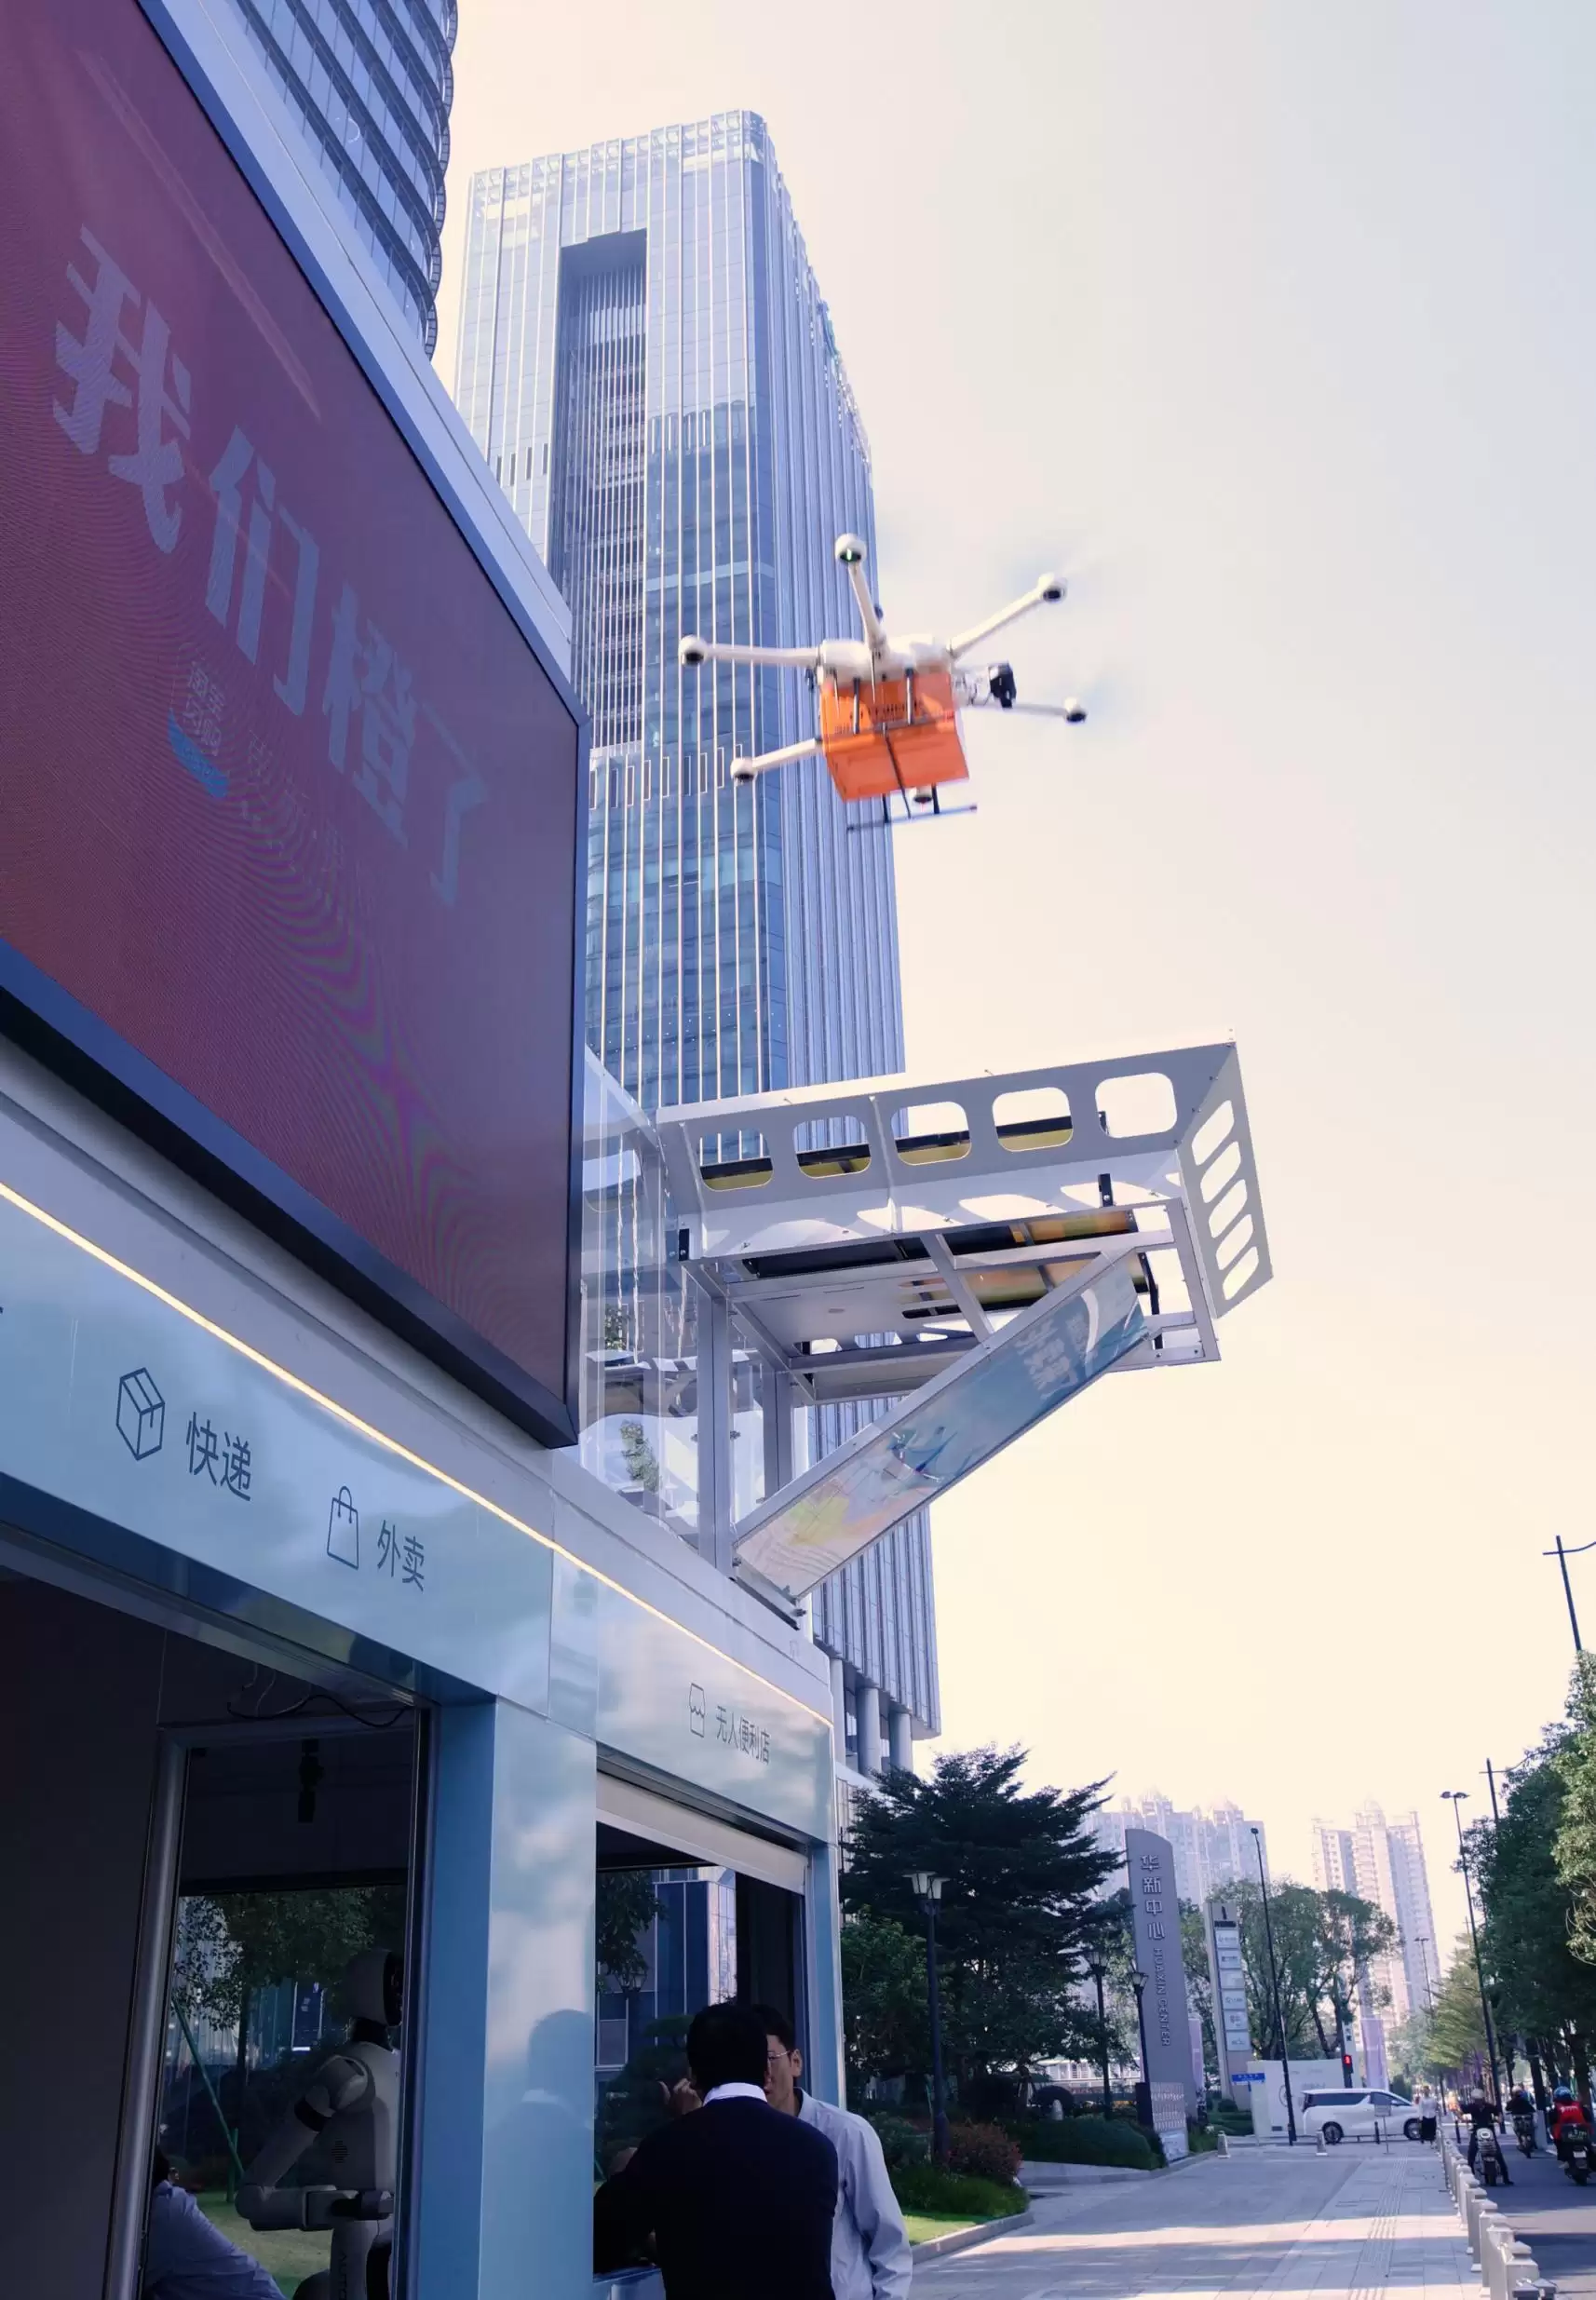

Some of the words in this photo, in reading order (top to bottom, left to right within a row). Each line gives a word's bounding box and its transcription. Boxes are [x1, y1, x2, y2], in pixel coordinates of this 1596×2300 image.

[53, 223, 492, 908] 我们橙了
[185, 1411, 251, 1502] 快递
[376, 1519, 425, 1592] 外卖
[715, 1705, 770, 1766] 无人便利店
[1140, 1854, 1166, 1941] 华新中心
[1153, 1948, 1167, 1996] HUAXIN
[1157, 1997, 1171, 2047] CENTER
